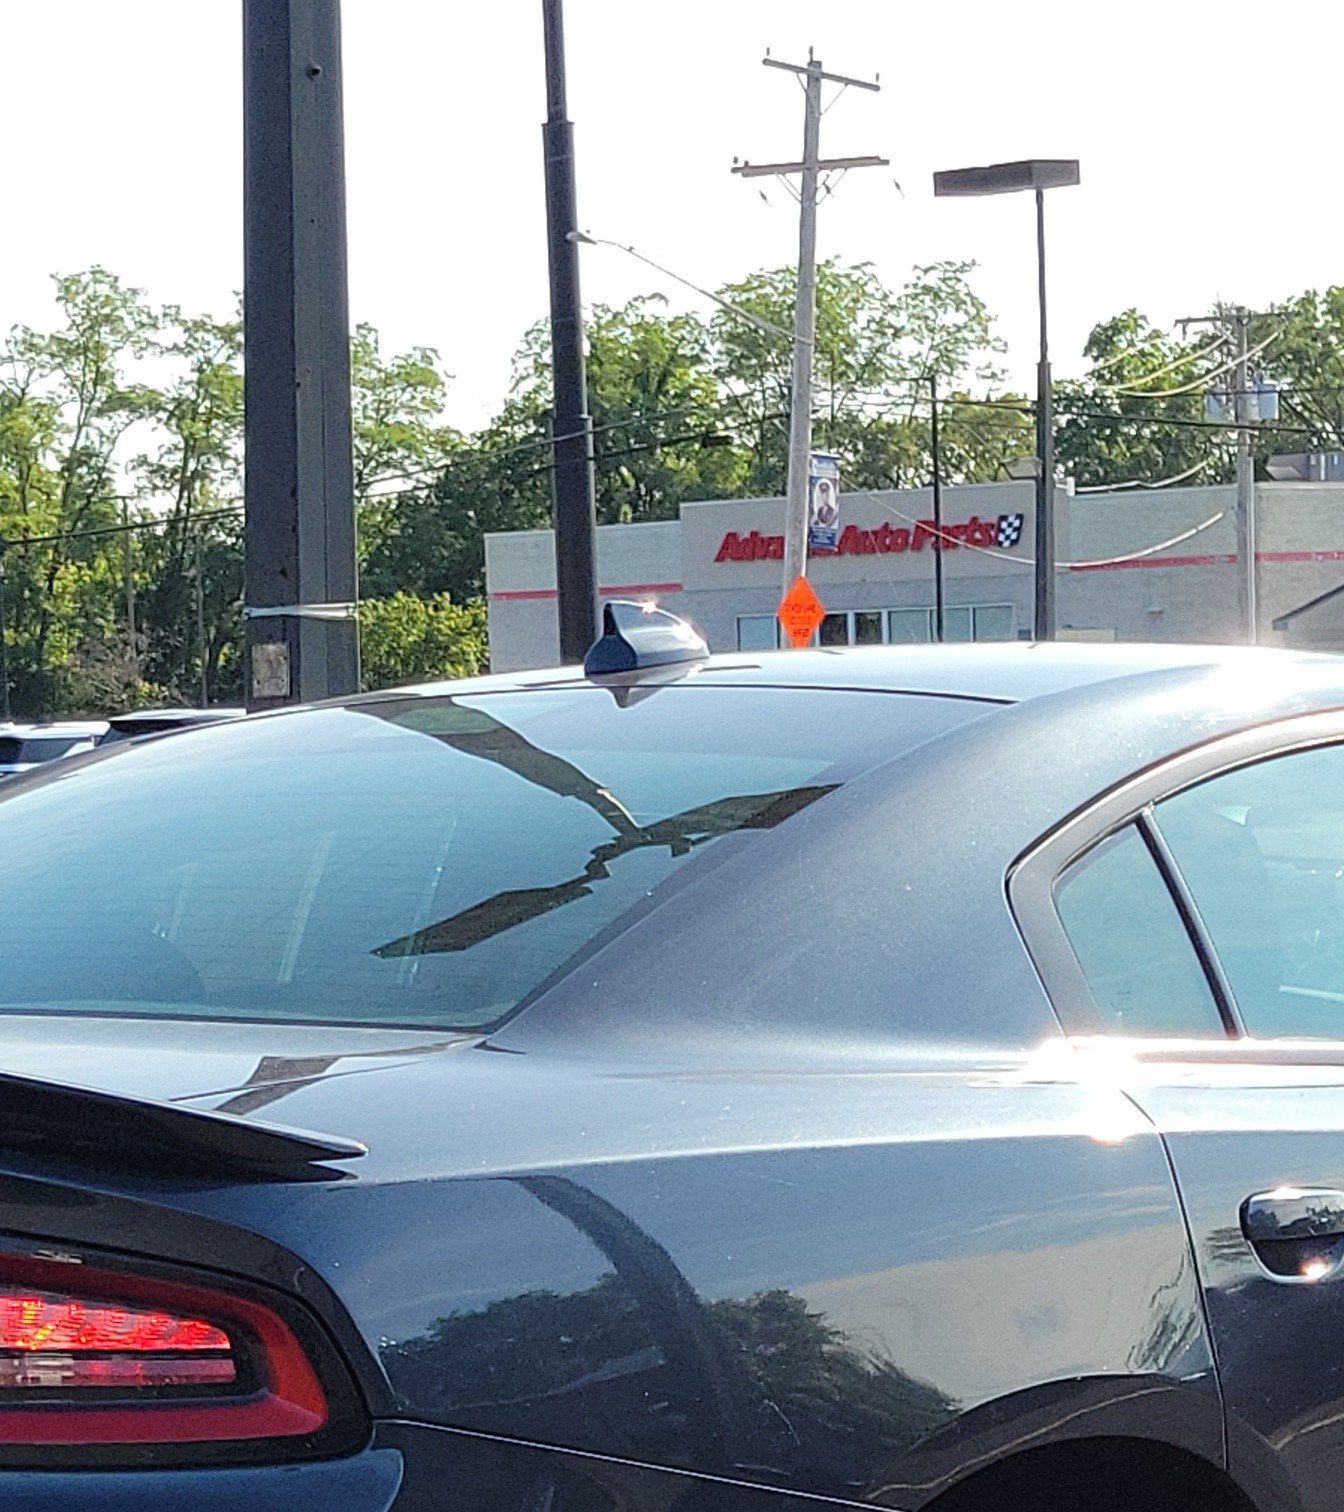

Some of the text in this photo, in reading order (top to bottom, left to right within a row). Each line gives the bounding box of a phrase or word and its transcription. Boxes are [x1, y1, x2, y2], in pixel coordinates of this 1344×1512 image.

[713, 531, 838, 562] Adva
[837, 523, 911, 556] Auto
[910, 516, 1000, 552] Parts
